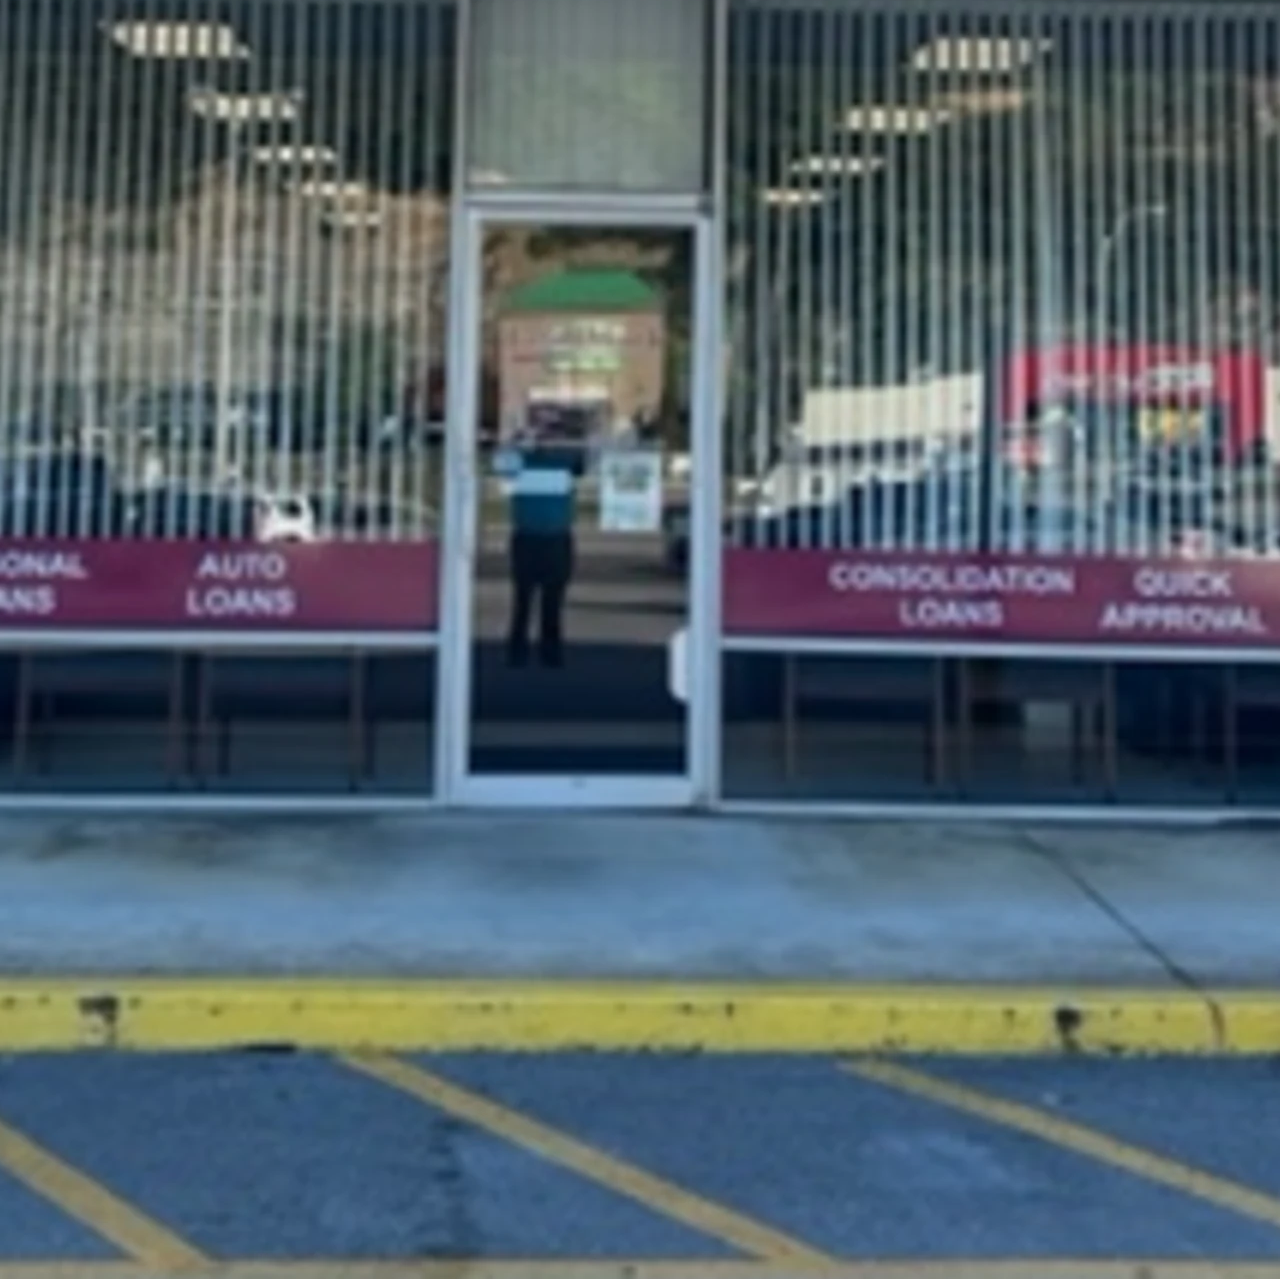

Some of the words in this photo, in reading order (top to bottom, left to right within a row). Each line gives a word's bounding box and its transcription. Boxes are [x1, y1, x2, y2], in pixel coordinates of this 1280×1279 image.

[196, 552, 285, 580] AUTO
[828, 563, 1074, 595] CONSOLIDATION
[1133, 567, 1232, 598] QUICK
[186, 586, 296, 617] LOANS
[899, 598, 1004, 628] LOANS
[1099, 603, 1266, 634] APPROVAL
